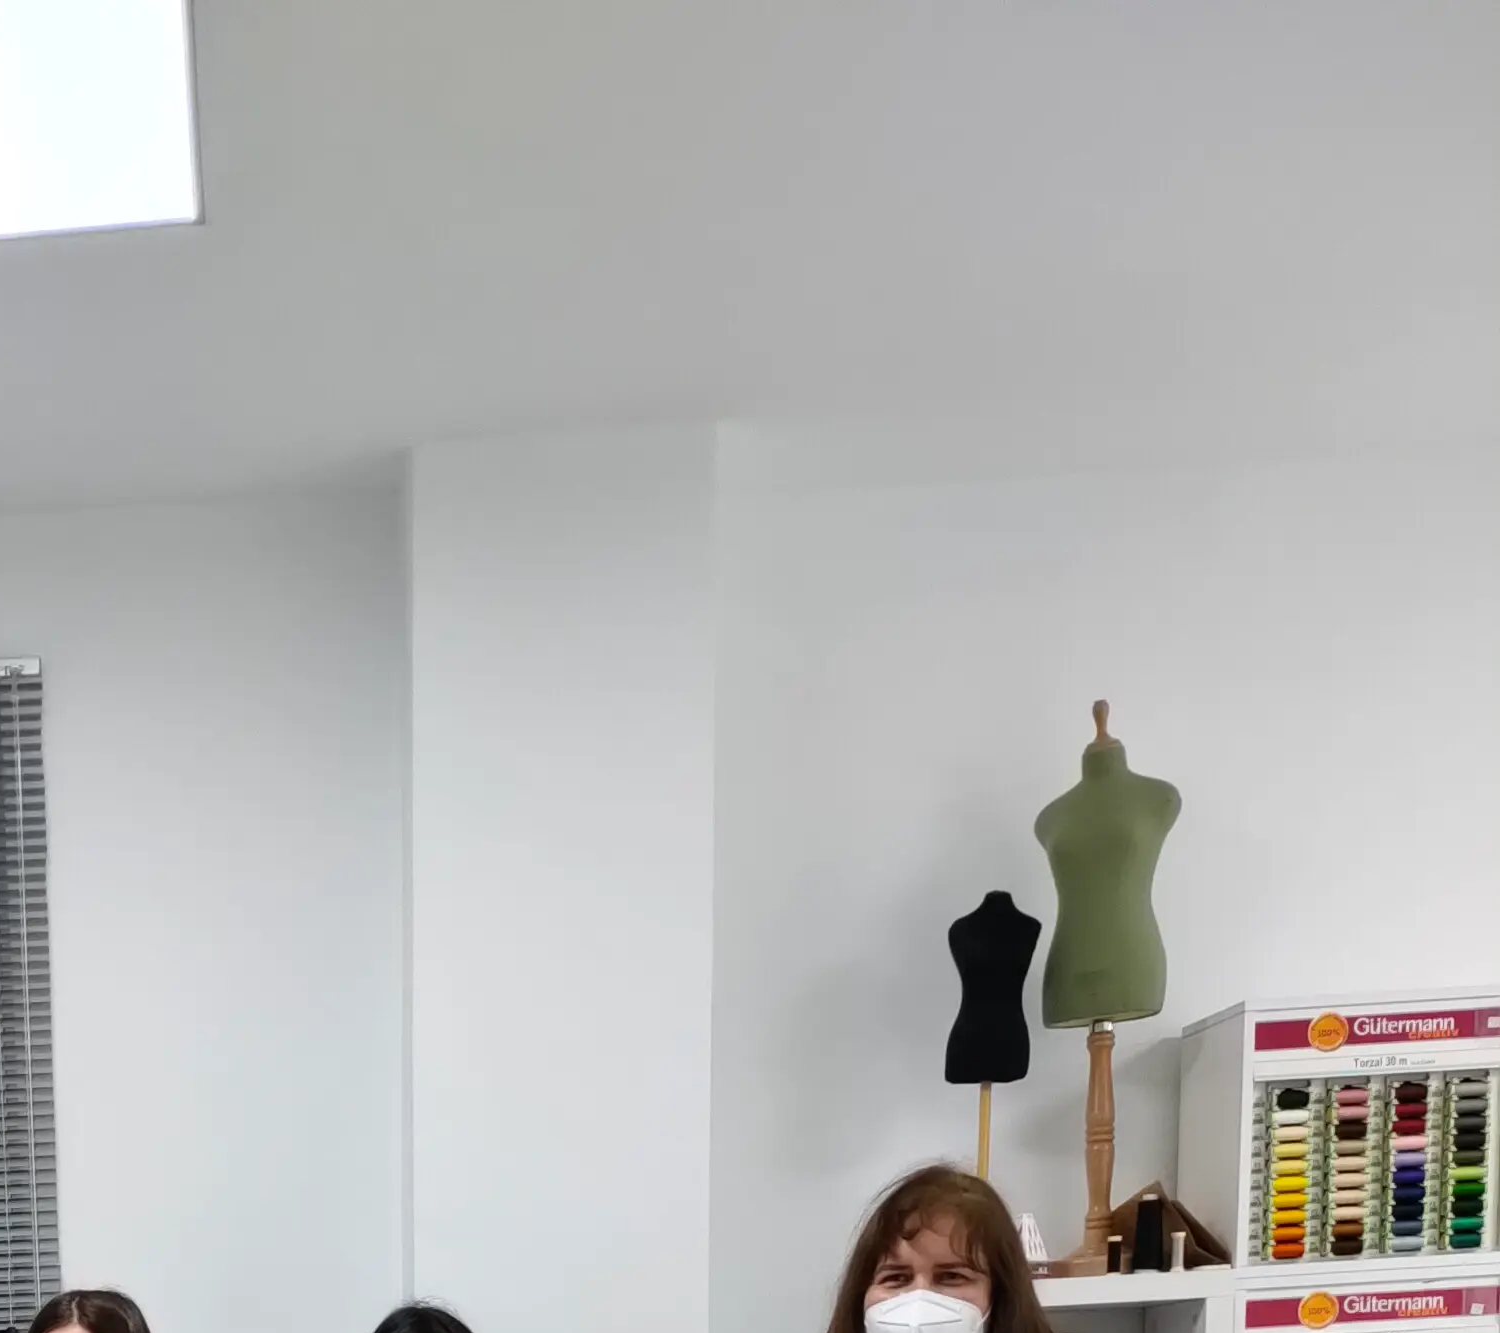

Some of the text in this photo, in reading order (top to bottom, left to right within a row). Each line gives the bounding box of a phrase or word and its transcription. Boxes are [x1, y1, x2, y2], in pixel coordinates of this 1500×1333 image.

[1353, 1016, 1455, 1036] Gütermann
[1353, 1057, 1382, 1069] Torzal
[1385, 1056, 1396, 1067] 30
[1398, 1057, 1408, 1066] m
[1343, 1295, 1444, 1314] Gütermann
